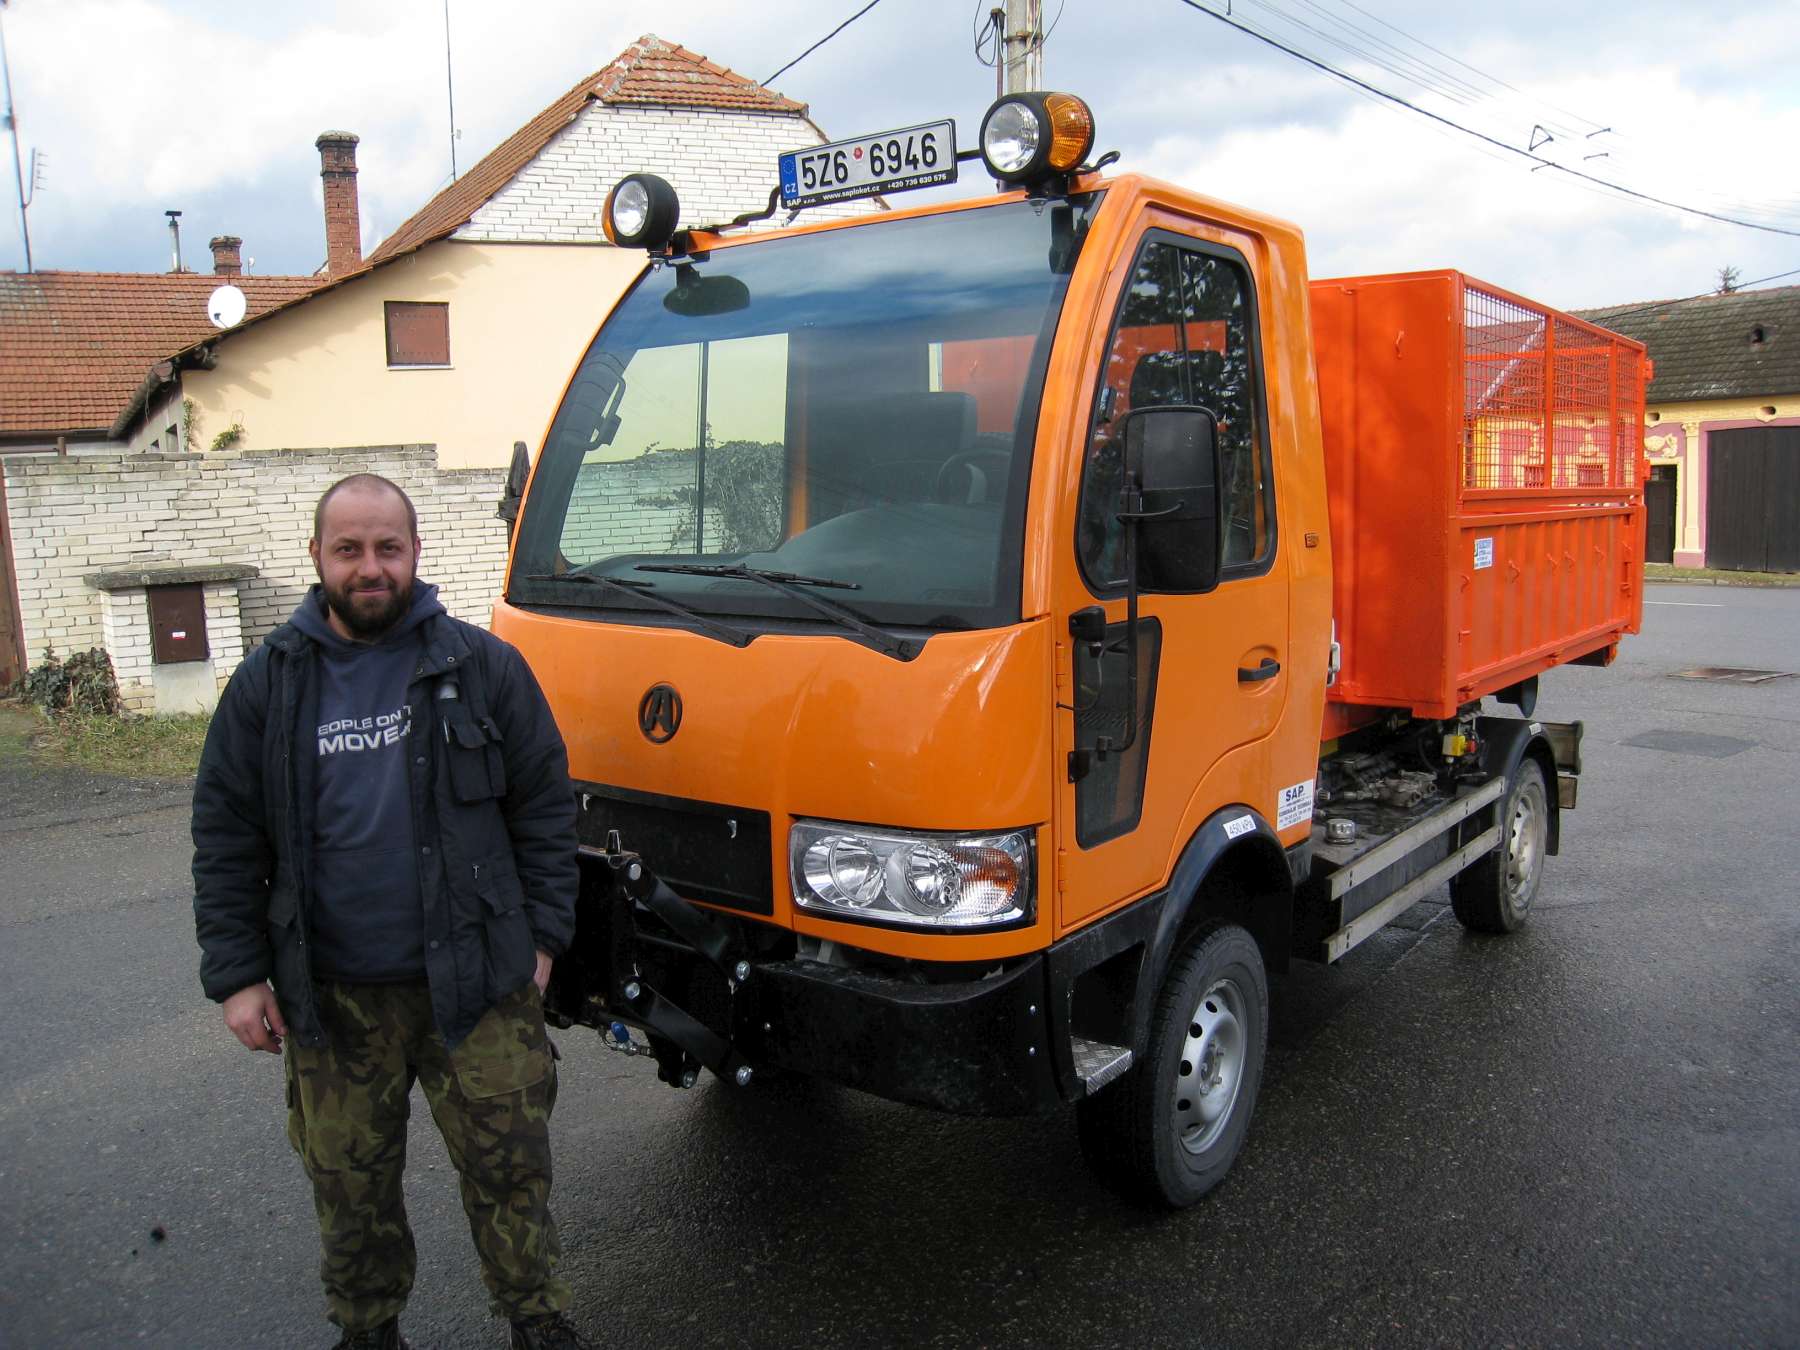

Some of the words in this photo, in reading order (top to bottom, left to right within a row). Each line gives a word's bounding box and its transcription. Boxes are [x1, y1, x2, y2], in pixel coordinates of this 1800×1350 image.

[801, 150, 849, 190] 5Z6
[869, 132, 938, 177] 6946
[785, 183, 797, 194] CZ
[786, 197, 802, 208] SAP
[375, 709, 402, 728] ON
[1285, 785, 1304, 802] SAP
